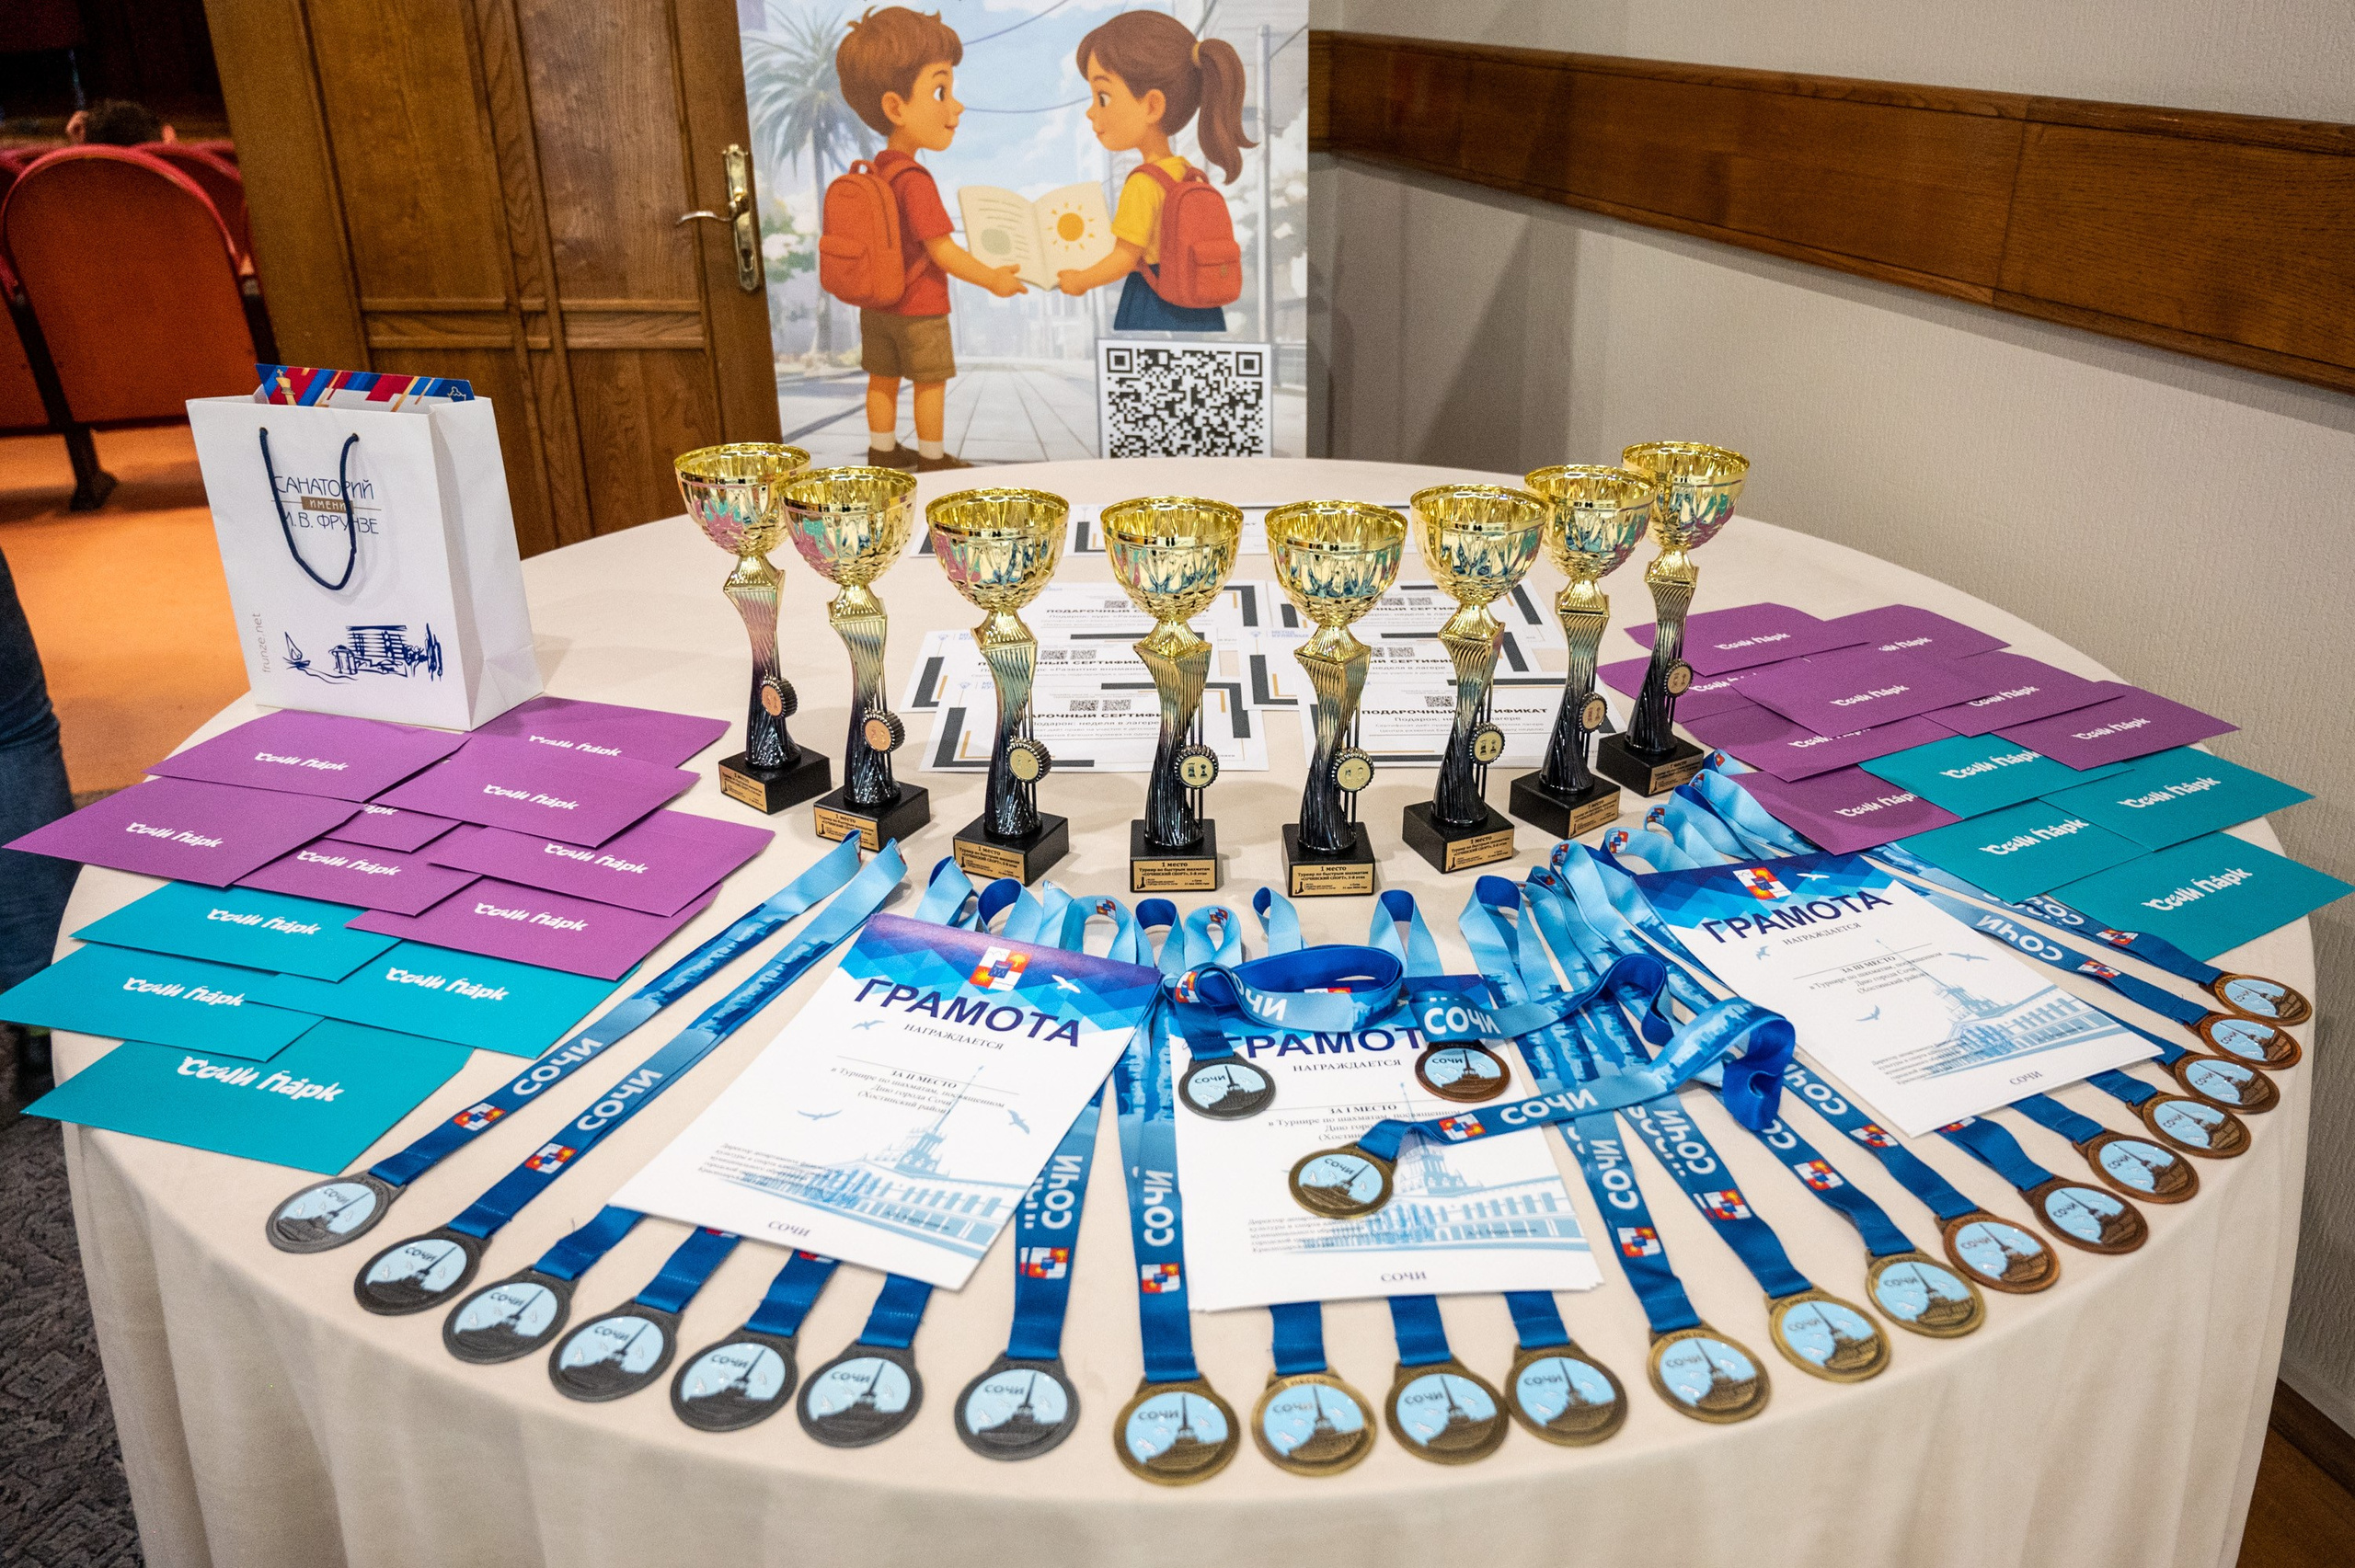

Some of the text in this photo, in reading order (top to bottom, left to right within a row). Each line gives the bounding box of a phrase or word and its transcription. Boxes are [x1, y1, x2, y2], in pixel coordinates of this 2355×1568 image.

[309, 499, 347, 511] ИМЕНИ
[252, 612, 272, 674] frunze.net
[364, 805, 398, 816] арк
[1702, 889, 1893, 944] ГРАМОТА
[1782, 922, 1862, 945] НАГРАЖДАЕТСЯ
[1976, 914, 2063, 961] СОЧИ
[1864, 956, 1897, 968] МЕСТО
[1231, 972, 1288, 1022] ОЧИ
[2234, 990, 2250, 1002] СОЧИ
[854, 978, 1080, 1047] ГРАМОТА
[1423, 1006, 1502, 1036] СОЧИ
[904, 1024, 1005, 1050] НАГРАЖДАЕТСЯ
[1224, 1026, 1420, 1059] РАМОТ
[2221, 1030, 2239, 1045] СОЧИ
[512, 1036, 603, 1096] СОЧИ
[1292, 1059, 1402, 1072] НАГРАЖДАЕТСЯ
[1430, 1056, 1464, 1065] СОЧИ
[916, 1074, 958, 1089] МЕСТО
[1194, 1073, 1227, 1085] СОЧИ
[2009, 1070, 2043, 1086] СОЧИ
[2195, 1071, 2215, 1087] СОЧИ
[577, 1069, 663, 1131] СОЧИ
[1353, 1103, 1397, 1113] МЕСТО
[1499, 1088, 1599, 1125] СОЧИ
[2163, 1114, 2183, 1128] СОЧИ
[1654, 1109, 1717, 1176] СОЧИ
[1323, 1156, 1355, 1176] СОЧИ
[2108, 1155, 2130, 1170] СОЧИ
[1590, 1139, 1639, 1210] СОЧИ
[323, 1186, 350, 1205] СОЧИ
[1041, 1155, 1084, 1230] СОЧИ
[1143, 1169, 1176, 1247] СОЧИ
[2052, 1203, 2078, 1219] СОЧИ
[767, 1219, 811, 1238] СОЧИ
[1961, 1236, 1992, 1251] СОЧИ
[405, 1246, 437, 1264] СОЧИ
[1380, 1270, 1427, 1283] СОЧИ
[1883, 1276, 1920, 1288] СОЧИ
[489, 1290, 525, 1308] СОЧИ
[1787, 1317, 1821, 1332] СОЧИ
[593, 1325, 629, 1342] СОЧИ
[710, 1353, 750, 1369] СОЧИ
[1665, 1354, 1704, 1368] СОЧИ
[832, 1370, 870, 1384] СОЧИ
[1523, 1373, 1563, 1387] СОЧИ
[984, 1383, 1025, 1395] СОЧИ
[1404, 1392, 1443, 1406] СОЧИ
[1137, 1408, 1179, 1422] СОЧИ
[1272, 1401, 1314, 1414] СОЧИ
